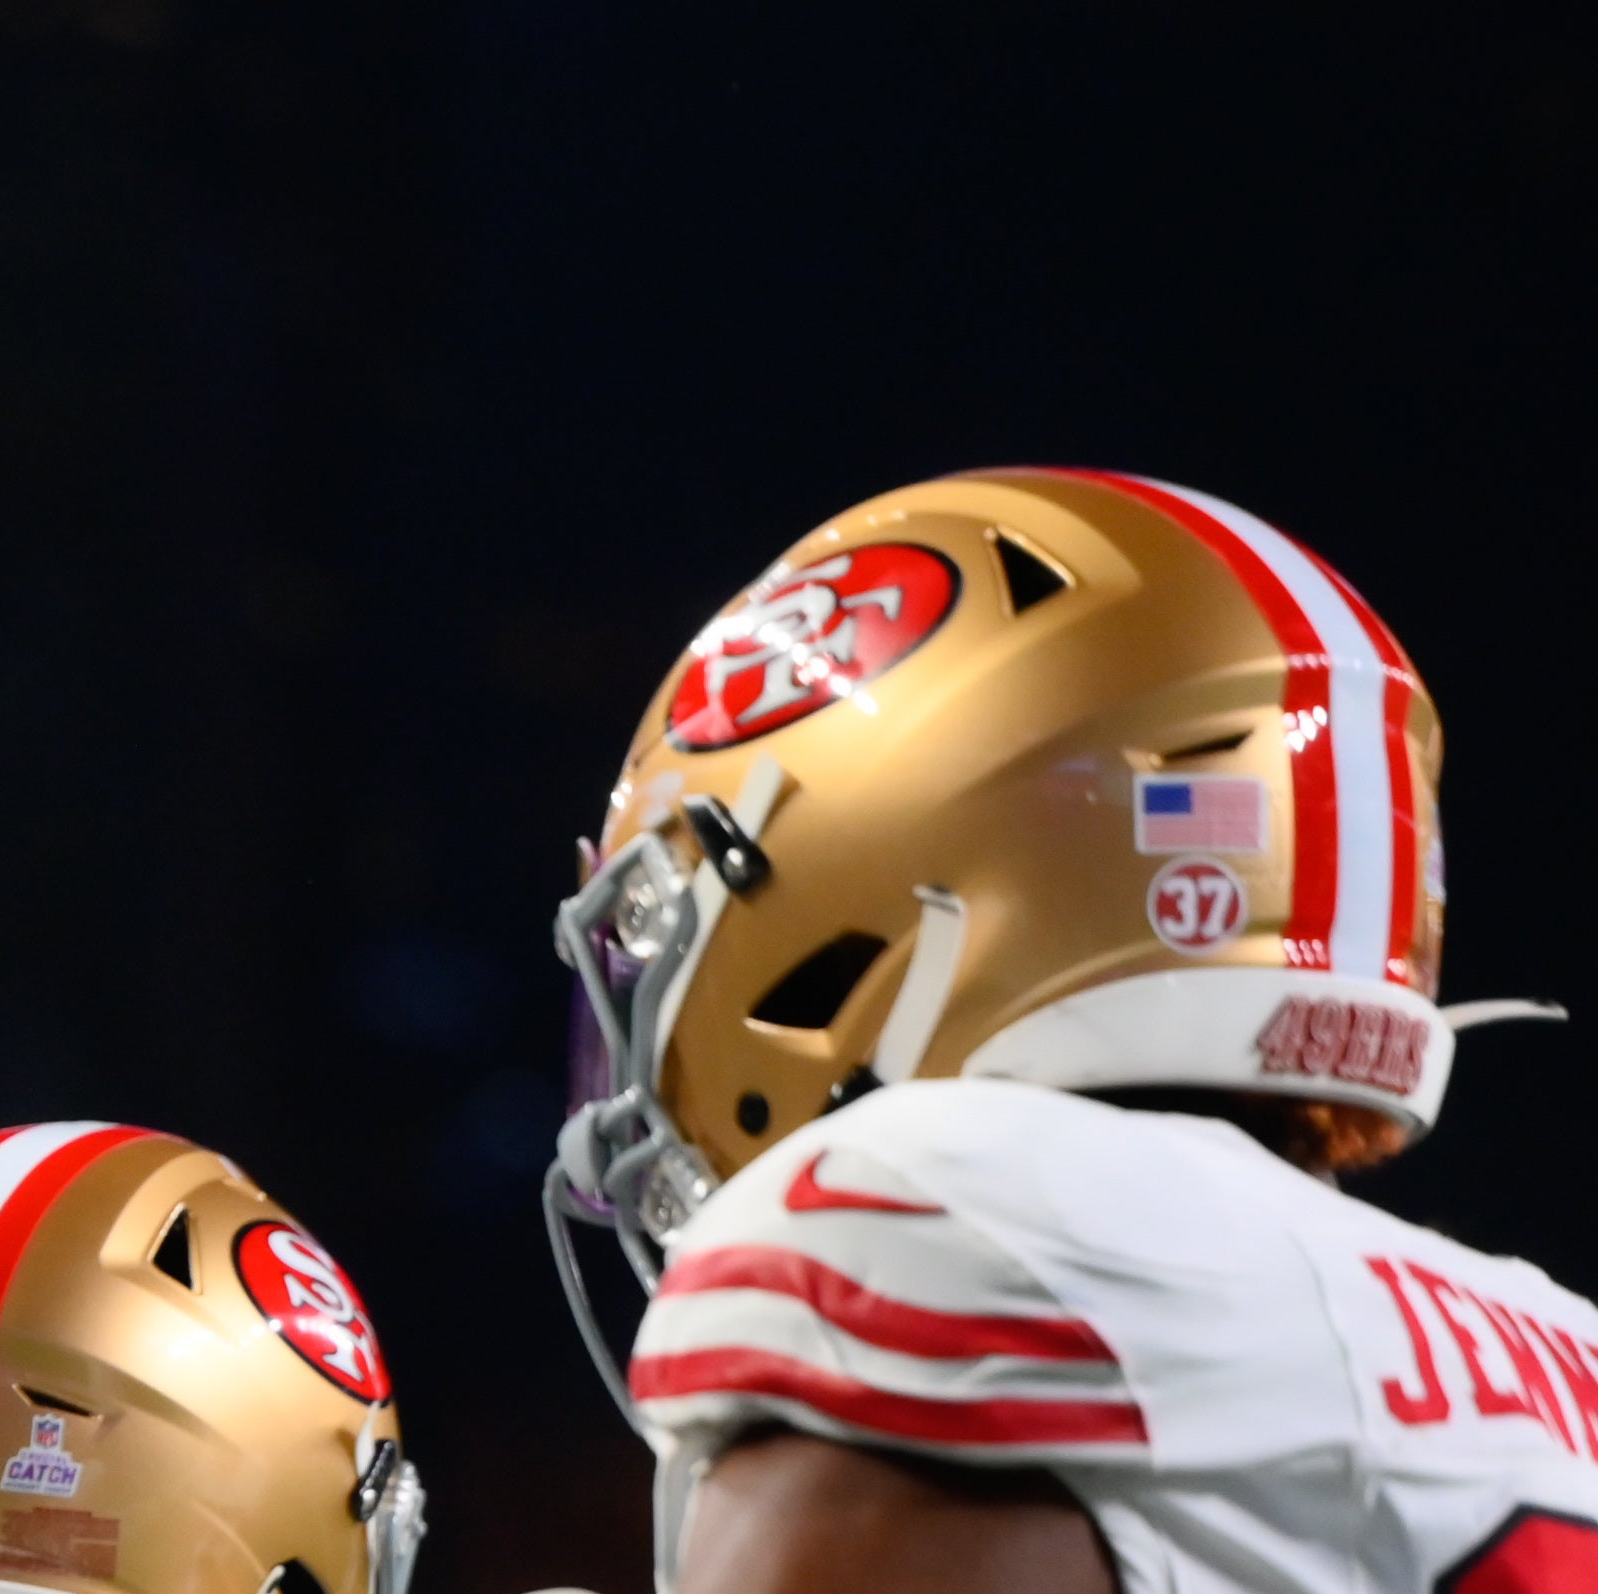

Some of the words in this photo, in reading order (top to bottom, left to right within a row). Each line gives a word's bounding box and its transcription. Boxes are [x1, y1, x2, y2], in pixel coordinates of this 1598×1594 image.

[1157, 873, 1235, 938] 37
[1361, 1255, 1598, 1466] JENN
[8, 1462, 77, 1484] CATCH
